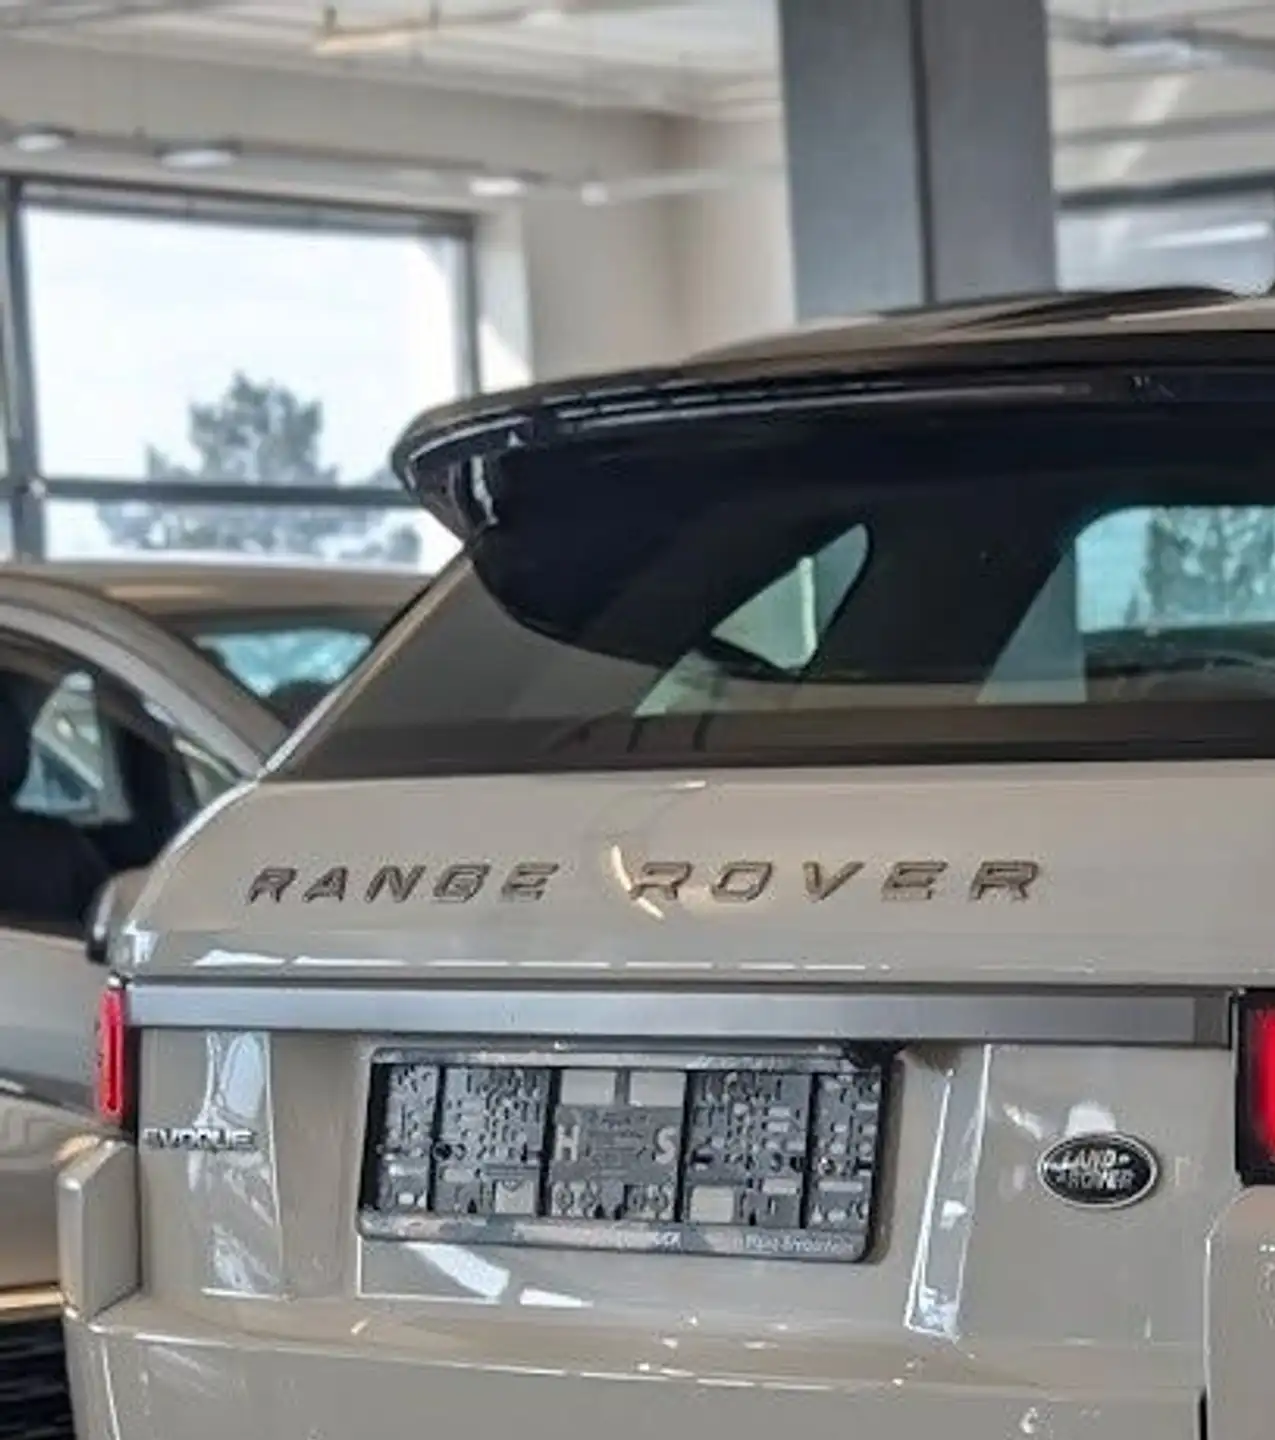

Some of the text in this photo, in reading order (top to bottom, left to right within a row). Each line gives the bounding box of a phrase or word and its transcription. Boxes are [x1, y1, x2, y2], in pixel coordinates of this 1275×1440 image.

[246, 861, 1039, 903] RANGE ROVER
[1061, 1148, 1117, 1169] LAND
